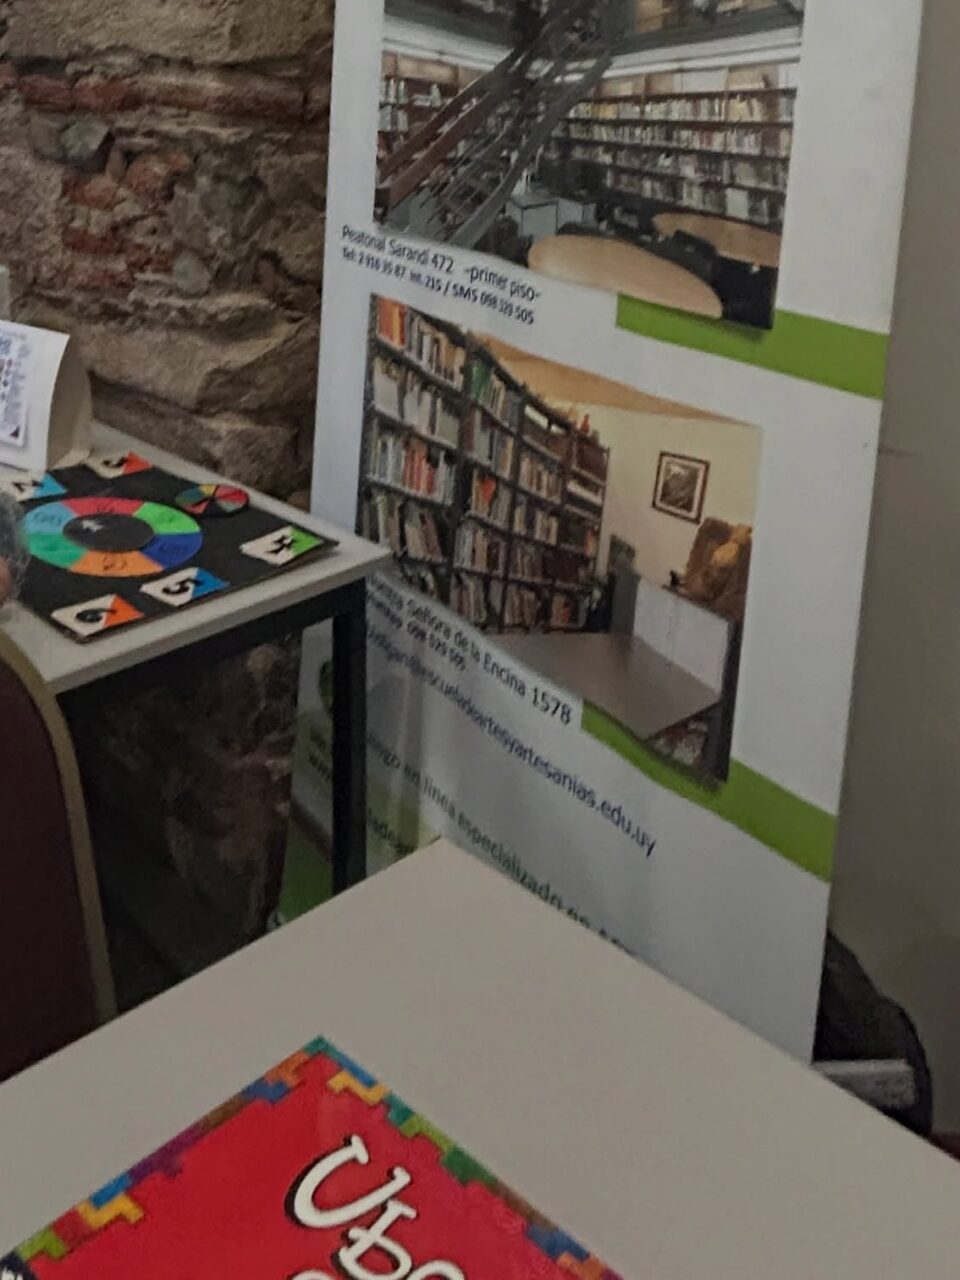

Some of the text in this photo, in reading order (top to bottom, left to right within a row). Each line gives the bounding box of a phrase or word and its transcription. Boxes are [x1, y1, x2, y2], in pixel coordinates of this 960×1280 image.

[432, 253, 454, 273] 472
[483, 652, 527, 697] Encina
[531, 686, 574, 726] 1578
[286, 1134, 467, 1280] Ub
